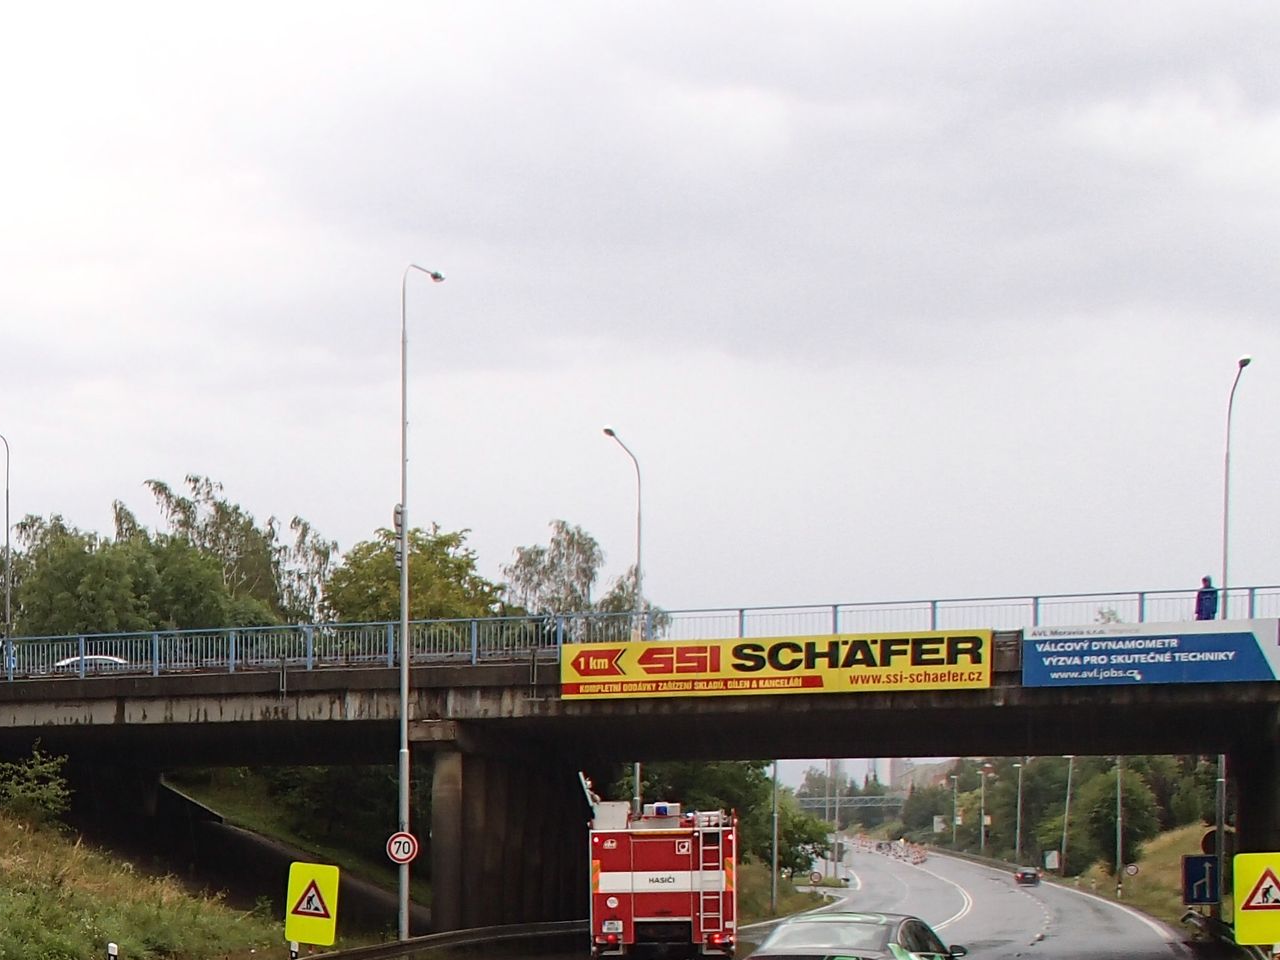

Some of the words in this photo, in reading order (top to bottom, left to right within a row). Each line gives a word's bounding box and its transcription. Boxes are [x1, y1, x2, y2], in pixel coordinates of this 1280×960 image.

[1035, 639, 1090, 652] VÁLCOVÝ
[1091, 638, 1179, 650] DYNAMOMETR
[637, 646, 721, 674] SSI
[731, 636, 983, 672] SCHÄFER
[1042, 654, 1082, 666] VÝZVA
[1083, 654, 1108, 664] PRO
[1109, 650, 1172, 664] SKUTEČNÉ
[1173, 650, 1236, 662] TECHNIKY
[578, 657, 585, 670] 1
[589, 656, 609, 670] km
[849, 671, 983, 685] www.ssi-schaefer.cz
[579, 682, 622, 694] KOMPLETNÍ
[622, 681, 657, 692] DODÁVKY
[751, 679, 758, 688] A
[394, 841, 411, 855] 70
[649, 876, 675, 884] HASIČI
